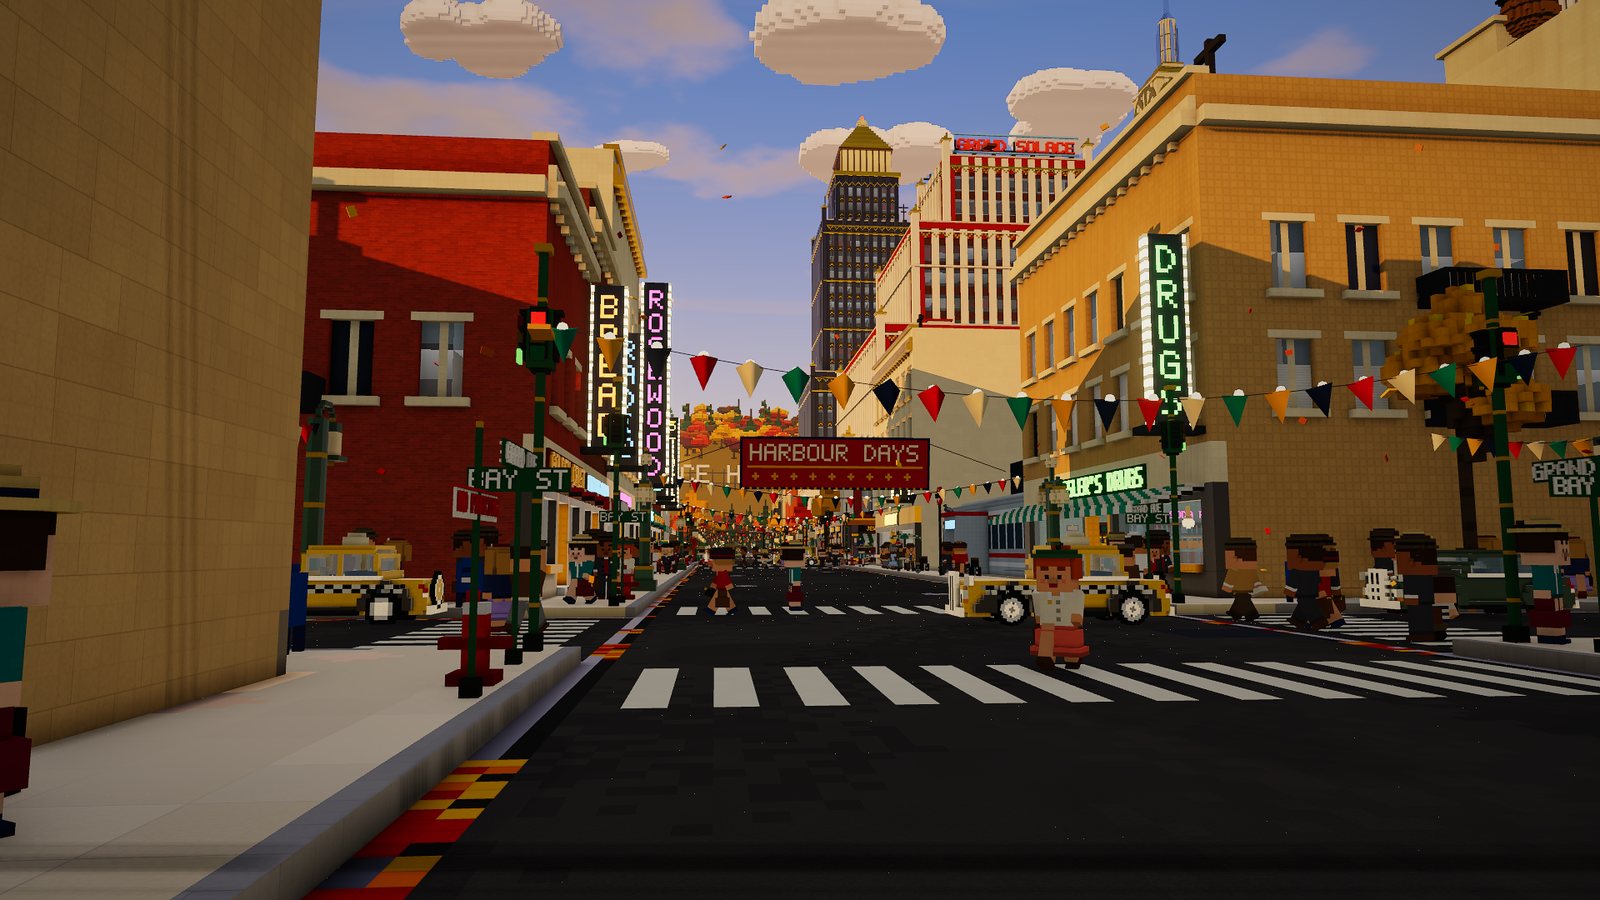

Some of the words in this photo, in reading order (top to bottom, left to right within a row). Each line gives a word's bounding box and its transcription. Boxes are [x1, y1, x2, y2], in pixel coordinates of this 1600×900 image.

[1015, 139, 1076, 154] SOLACE
[1154, 244, 1183, 416] DRUGS
[749, 443, 849, 463] HARBOUR
[863, 444, 919, 463] DAYS
[1532, 458, 1596, 481] GRAND
[536, 469, 569, 490] ST
[1552, 476, 1595, 495] BAY
[631, 511, 646, 522] ST
[1126, 513, 1148, 523] BAY
[1154, 513, 1169, 524] ST
